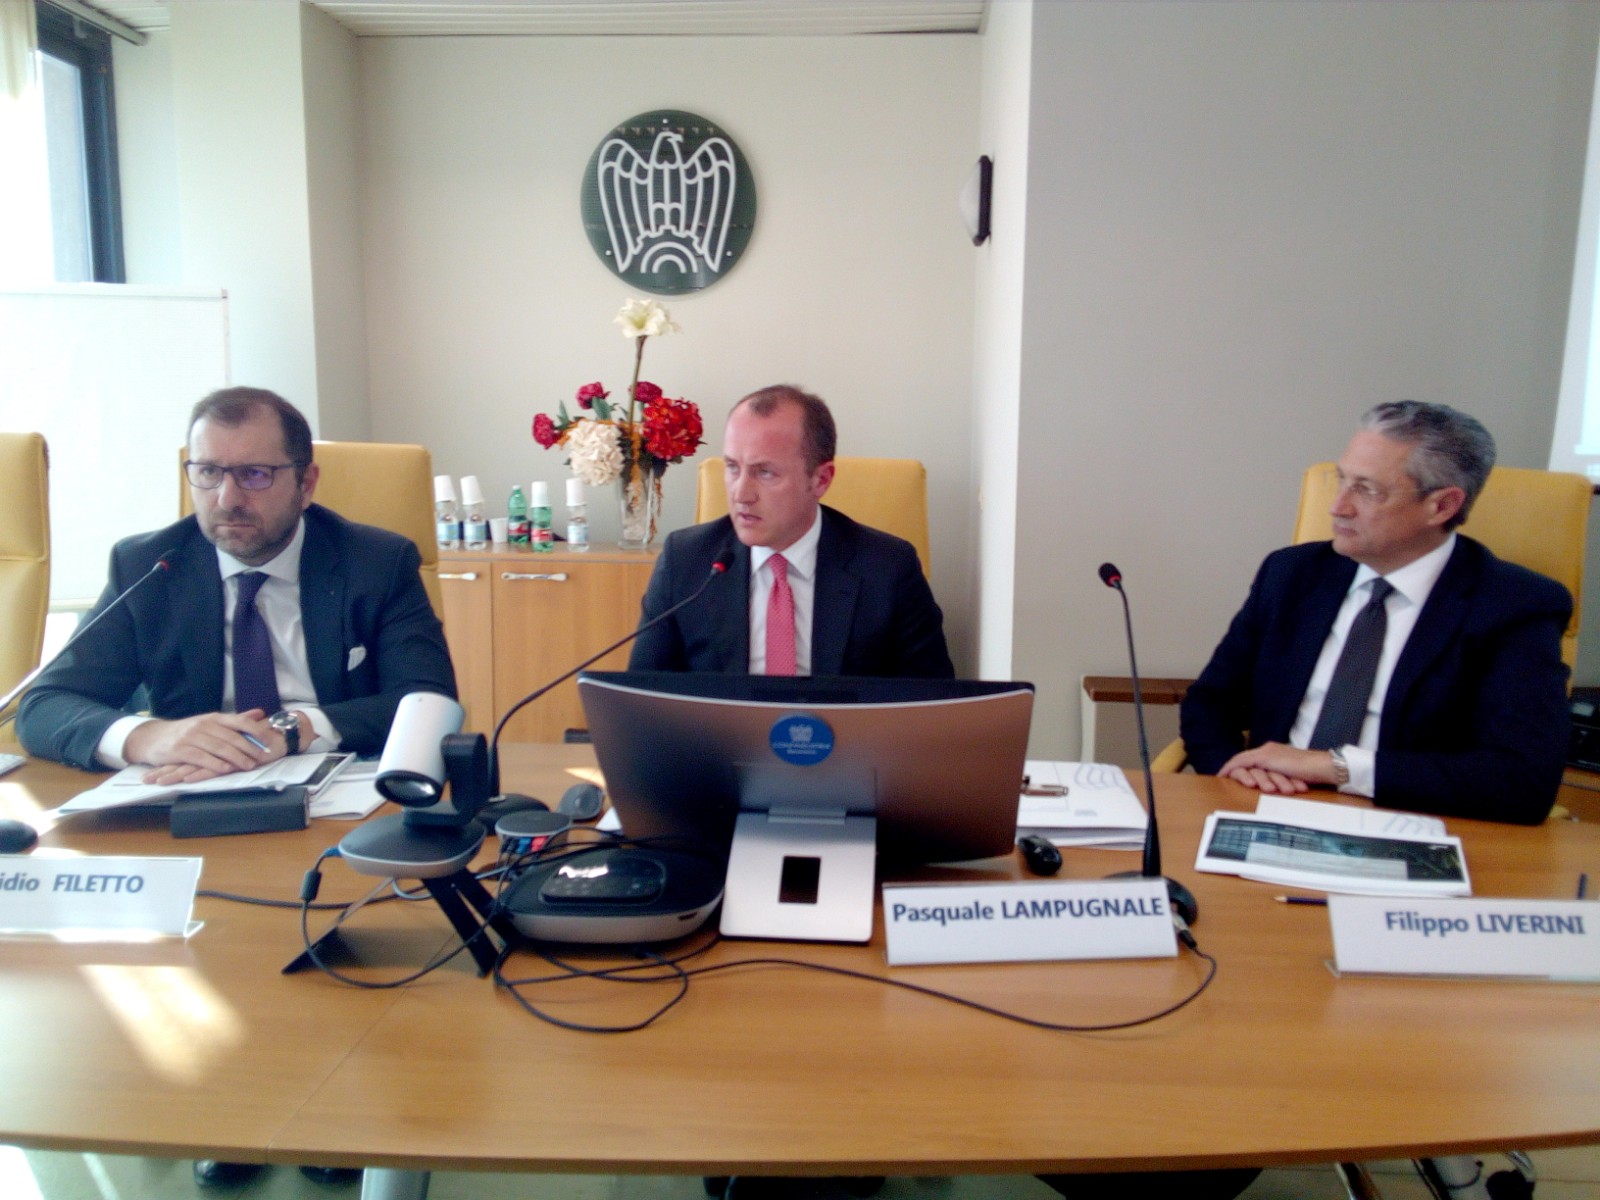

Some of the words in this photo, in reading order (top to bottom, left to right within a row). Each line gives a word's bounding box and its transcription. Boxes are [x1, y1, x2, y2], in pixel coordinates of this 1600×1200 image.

[53, 874, 144, 893] FILETTO
[893, 900, 994, 926] Pasquale
[1001, 897, 1164, 919] LAMPUGNALE
[1385, 911, 1469, 936] Filippo
[1477, 914, 1585, 935] LIVERINI
